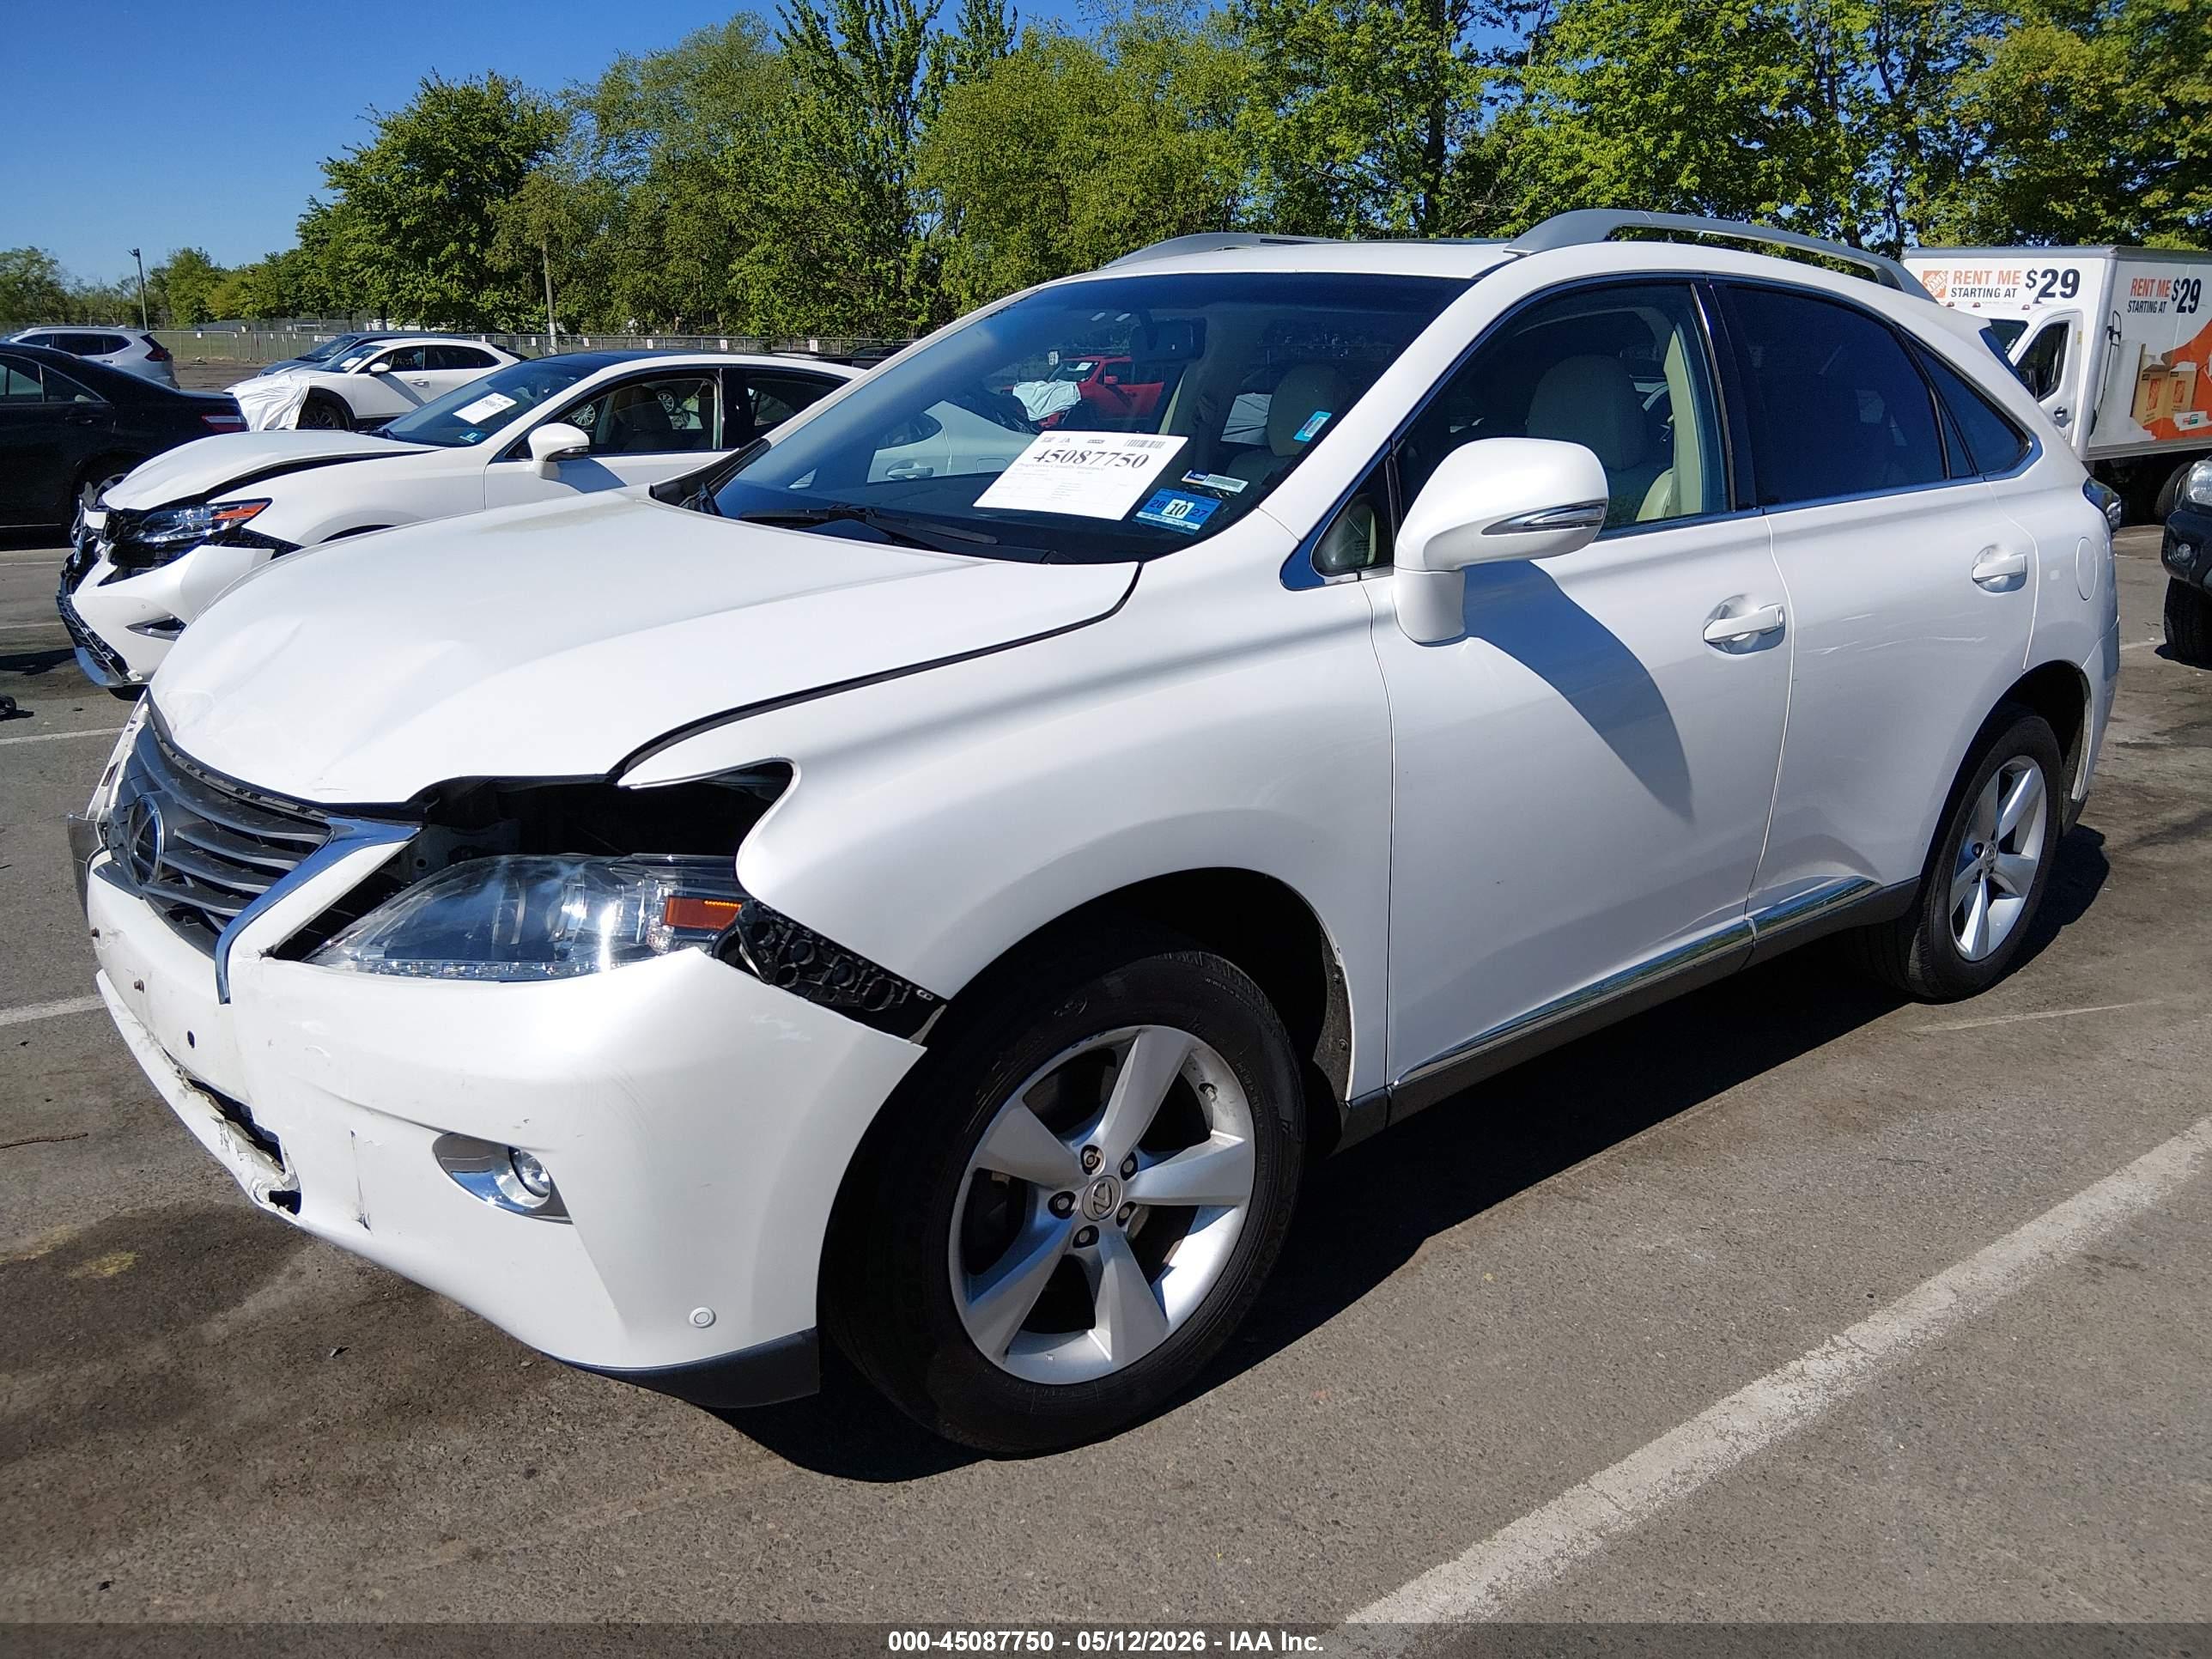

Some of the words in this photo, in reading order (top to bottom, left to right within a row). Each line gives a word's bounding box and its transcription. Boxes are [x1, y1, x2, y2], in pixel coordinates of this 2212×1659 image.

[1953, 270, 1993, 285] RENT
[1997, 270, 2022, 285] ME
[2025, 268, 2081, 299] $29
[2130, 277, 2156, 297] RENT
[2156, 279, 2172, 298] ME
[1950, 288, 2001, 298] STARTING
[2003, 288, 2018, 298] AT
[2171, 276, 2202, 314] $29
[2127, 300, 2158, 313] STARTING
[2158, 301, 2168, 313] AT
[1032, 448, 1151, 469] 45087750
[1150, 499, 1167, 509] 20
[1166, 502, 1188, 516] 10
[1189, 507, 1209, 518] 27
